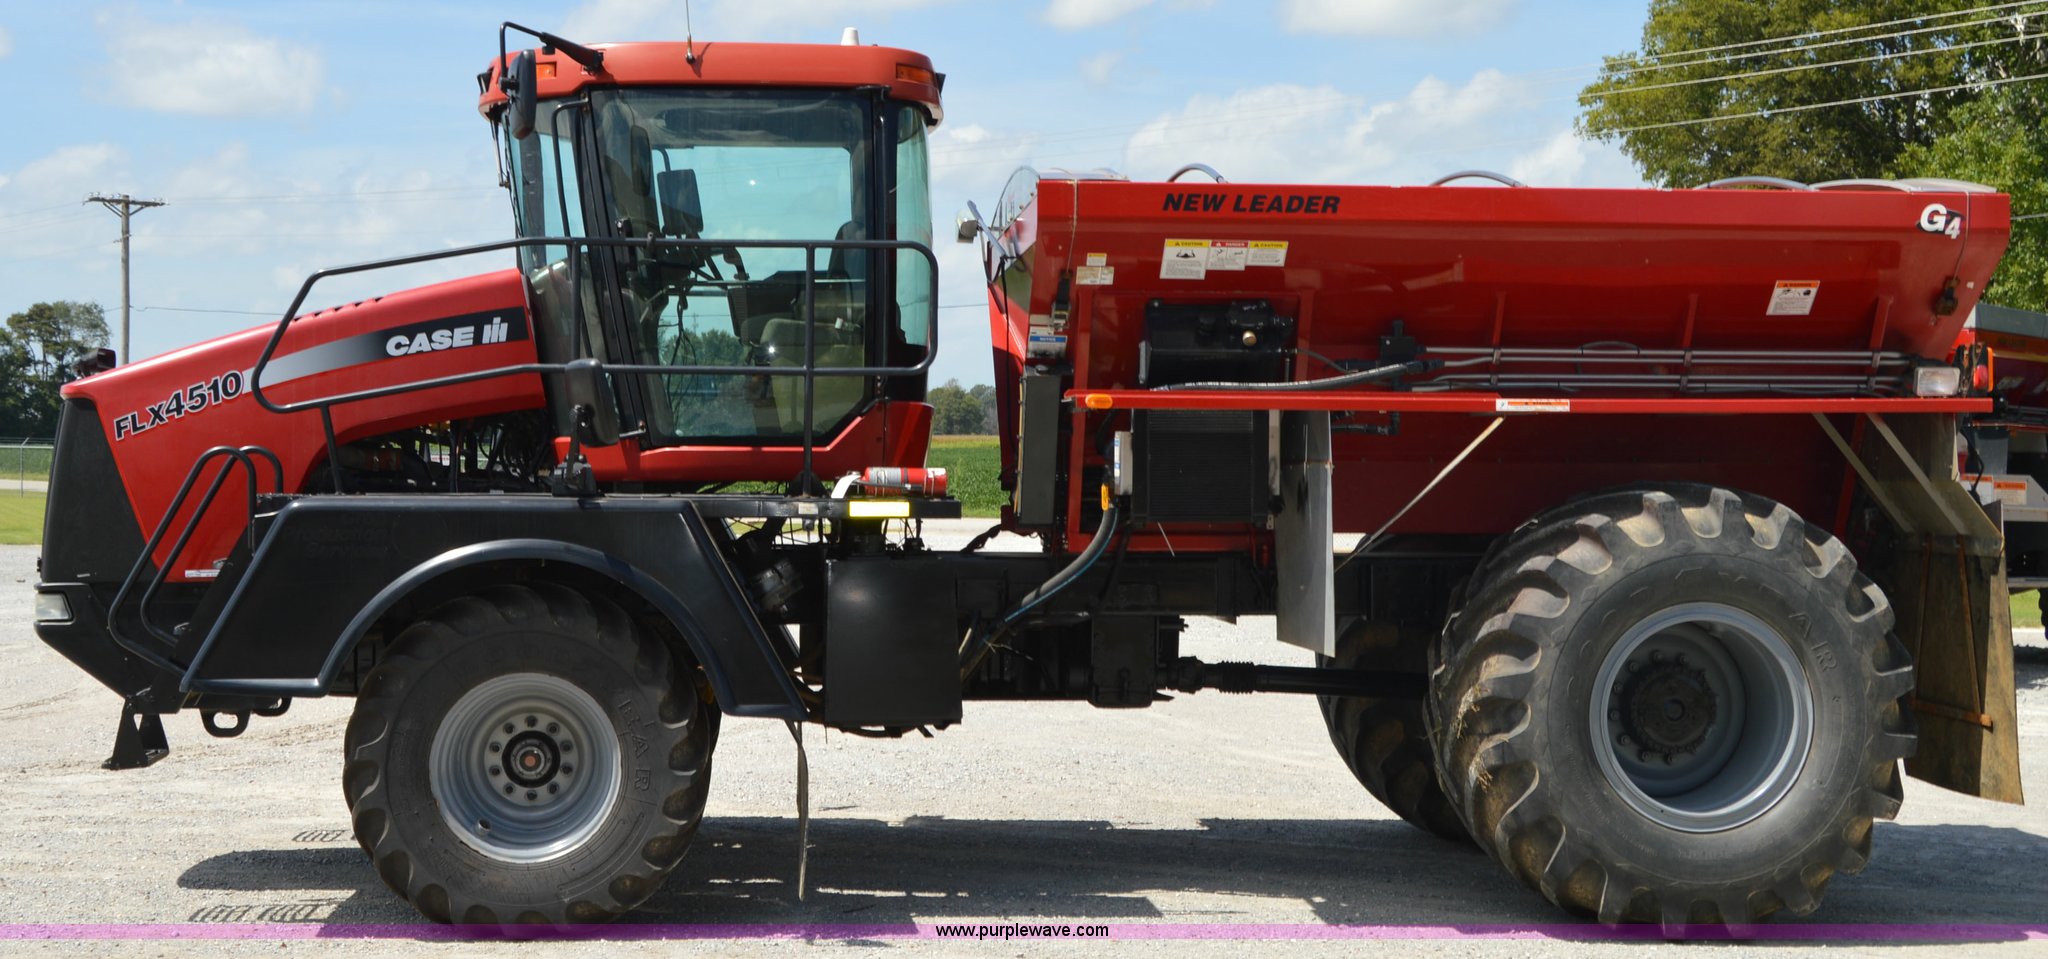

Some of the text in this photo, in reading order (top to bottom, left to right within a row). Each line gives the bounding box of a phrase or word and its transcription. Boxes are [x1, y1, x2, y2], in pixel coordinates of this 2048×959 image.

[1162, 193, 1341, 214] NEW LEADER
[1920, 203, 1961, 239] G4
[386, 325, 475, 356] CASE
